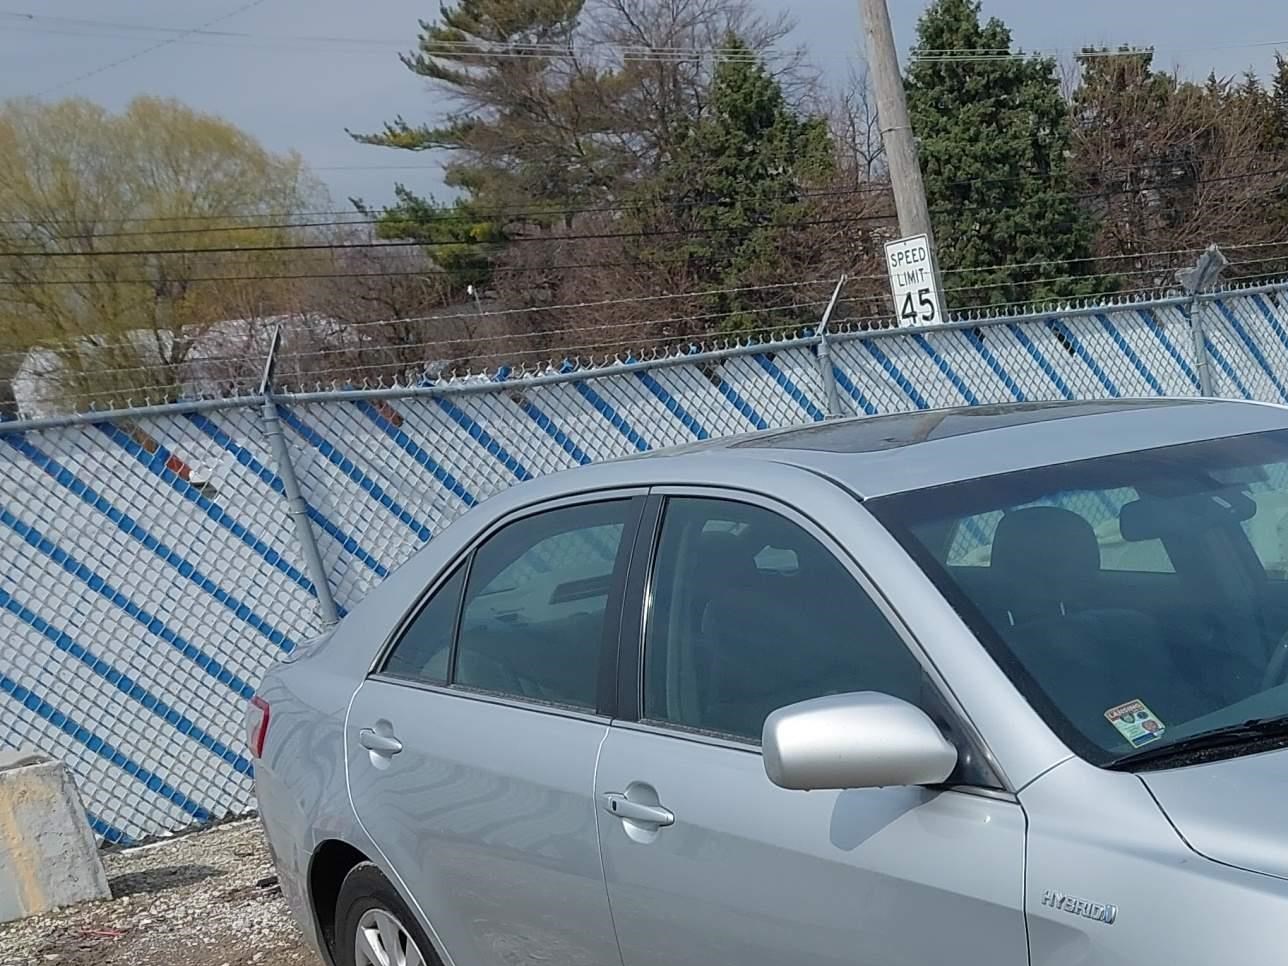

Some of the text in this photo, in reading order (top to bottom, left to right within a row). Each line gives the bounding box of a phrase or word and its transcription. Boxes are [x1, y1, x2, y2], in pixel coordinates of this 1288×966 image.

[890, 247, 926, 268] SPEED
[897, 267, 924, 287] LIMIT
[901, 287, 935, 324] 45
[1041, 890, 1105, 922] HYBRID
